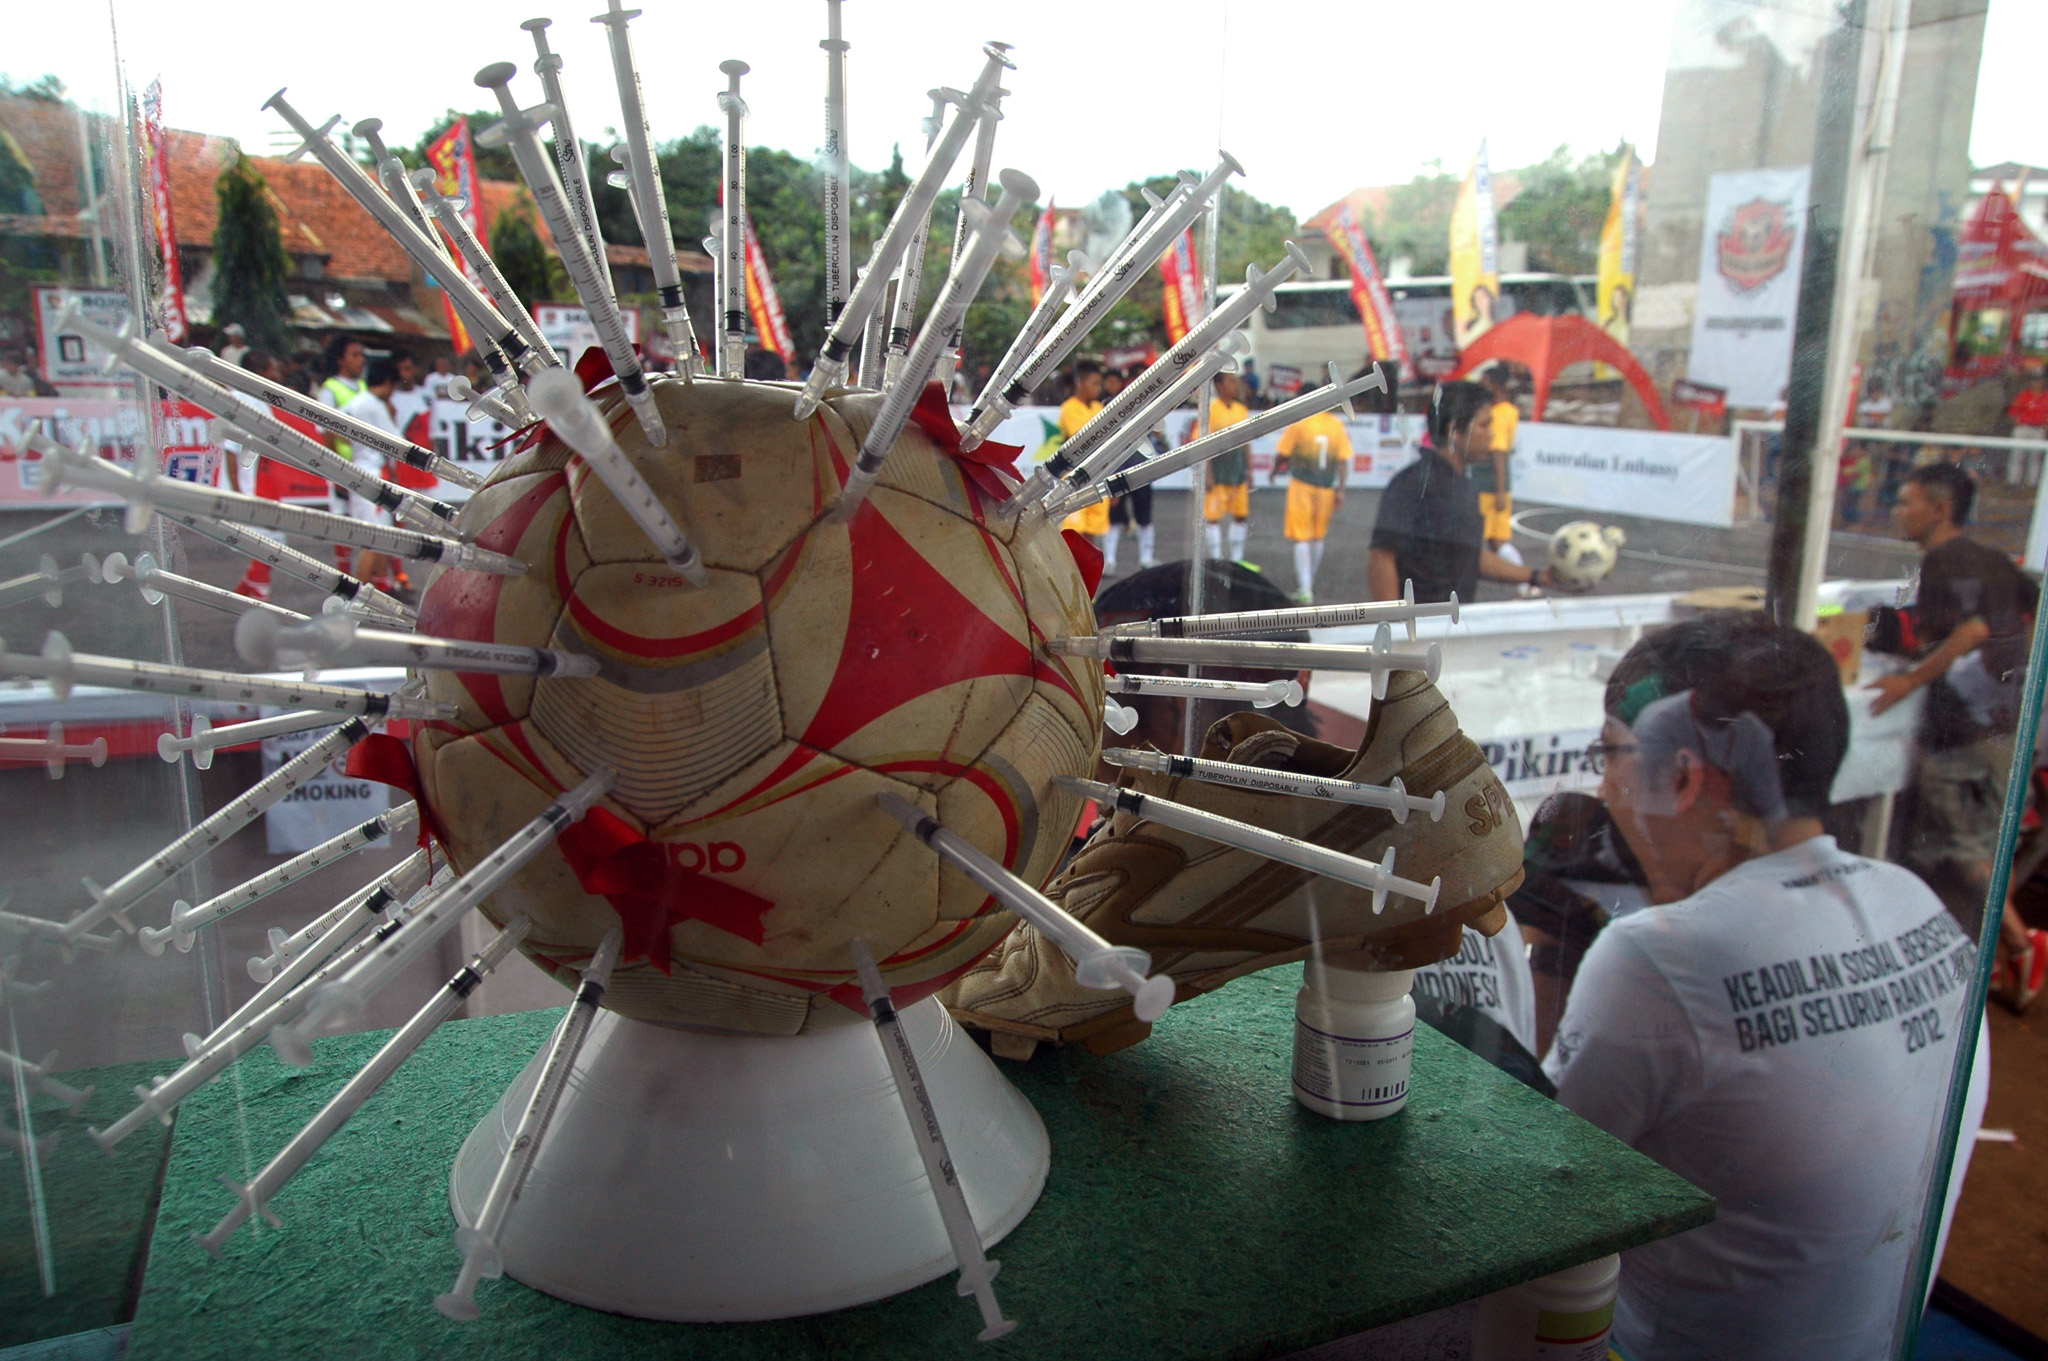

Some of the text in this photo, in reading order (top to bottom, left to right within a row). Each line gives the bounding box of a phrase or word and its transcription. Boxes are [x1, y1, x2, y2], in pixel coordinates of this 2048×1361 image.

[573, 177, 592, 231] DISPOSABLE
[832, 235, 840, 294] TUBERCULIN
[1023, 335, 1064, 379] TUBERCULIN
[1064, 291, 1106, 336] DISPOSABLE
[298, 405, 347, 432] DISPOSABLE
[349, 428, 400, 455] TUBERCULIN
[1073, 419, 1118, 458] TUBERCULIN
[1119, 377, 1165, 419] DISPOSABLE
[648, 576, 683, 588] SIZE
[1198, 770, 1248, 785] TUBERCULIN
[1250, 779, 1299, 793] DISPOSABLE
[1481, 735, 1606, 782] Pikira
[1723, 953, 1843, 1013] KEADILAN
[1841, 940, 1904, 985] SOSIAL
[1735, 1004, 1799, 1053] BAGI
[1801, 989, 1895, 1036] SELURUH
[1888, 959, 1955, 1013] RAKYAT
[1902, 1007, 1945, 1053] 2012
